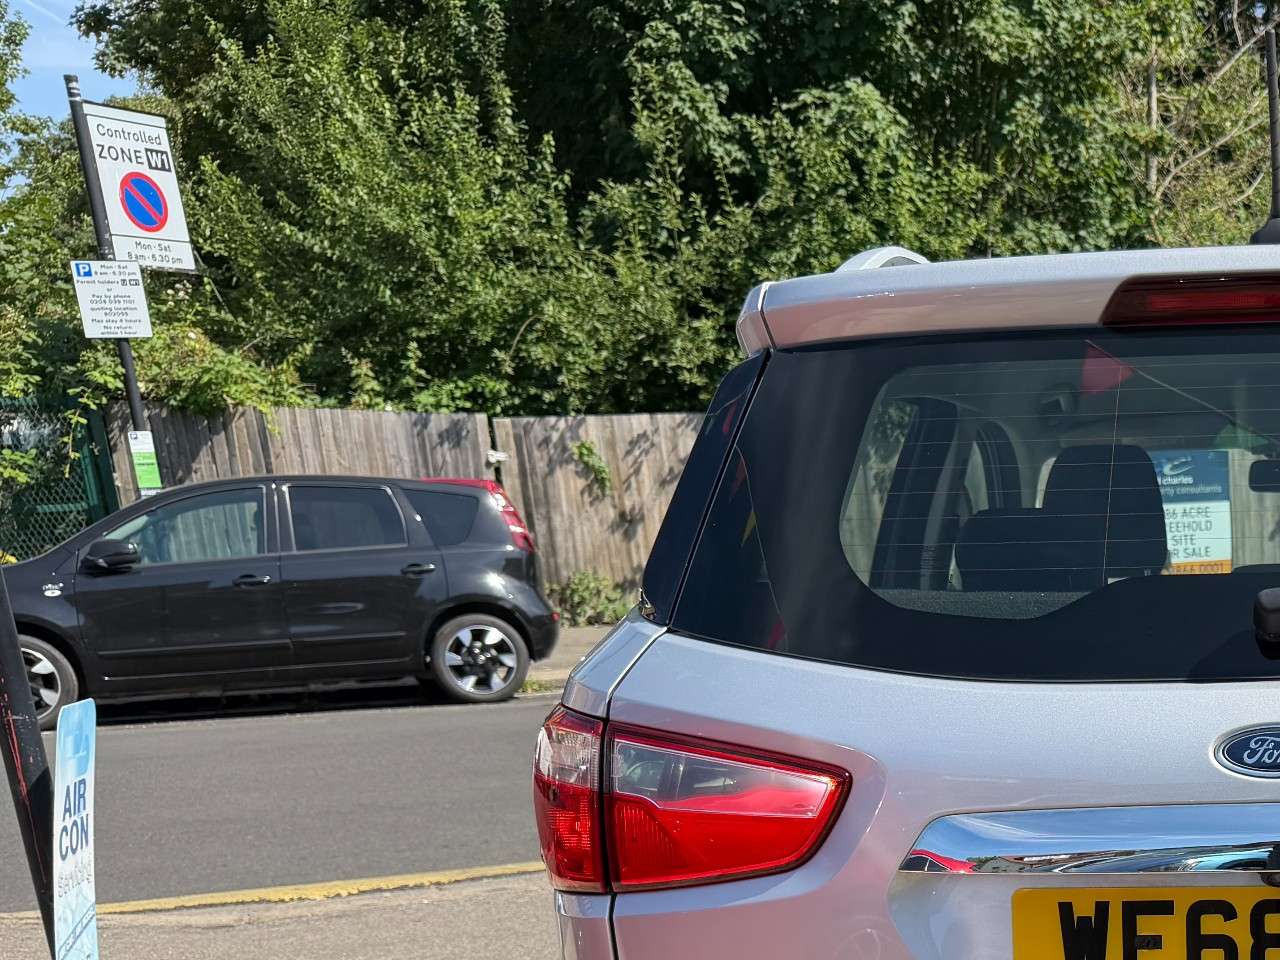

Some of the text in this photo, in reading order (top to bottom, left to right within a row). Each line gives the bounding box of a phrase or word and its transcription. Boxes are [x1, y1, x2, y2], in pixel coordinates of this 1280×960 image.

[96, 123, 162, 145] Controlled
[96, 143, 169, 170] ZONE W1
[135, 241, 152, 251] Mon
[157, 243, 171, 252] Sat
[171, 257, 183, 265] pm
[78, 264, 90, 277] P
[1181, 506, 1211, 519] ACRE
[1169, 520, 1213, 533] EEHOLD
[1171, 534, 1197, 546] SITE
[1183, 546, 1212, 559] SALE
[62, 778, 87, 822] AIR
[59, 814, 89, 861] CON
